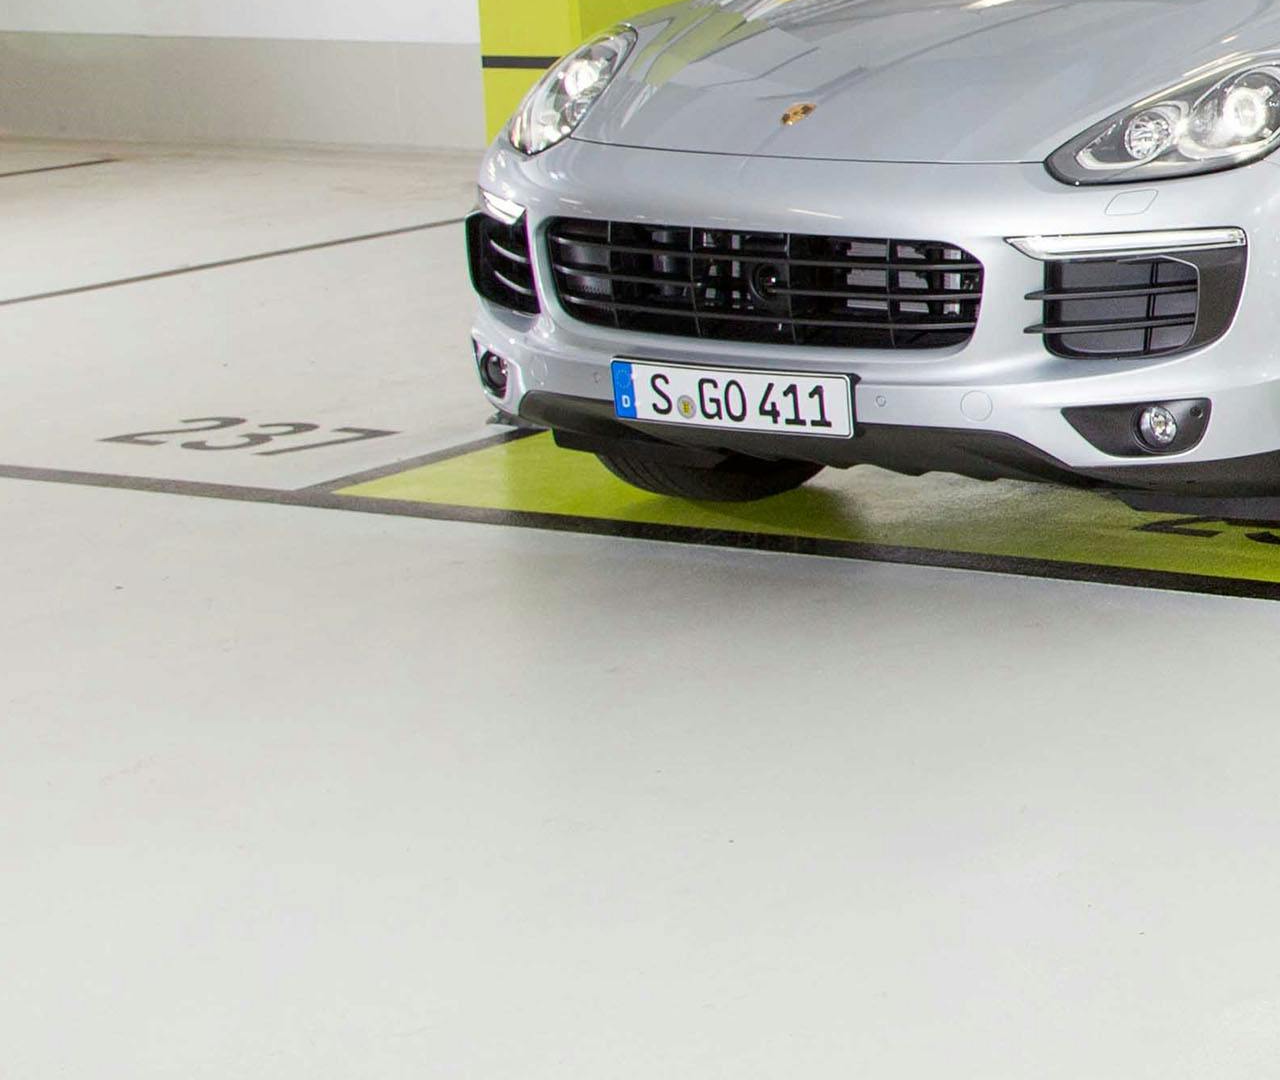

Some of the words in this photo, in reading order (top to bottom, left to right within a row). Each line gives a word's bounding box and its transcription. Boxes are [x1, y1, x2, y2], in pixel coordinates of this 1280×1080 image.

[621, 395, 631, 408] D
[651, 373, 673, 415] S
[698, 378, 747, 423] GO
[759, 382, 832, 428] 411
[96, 416, 403, 456] 237
